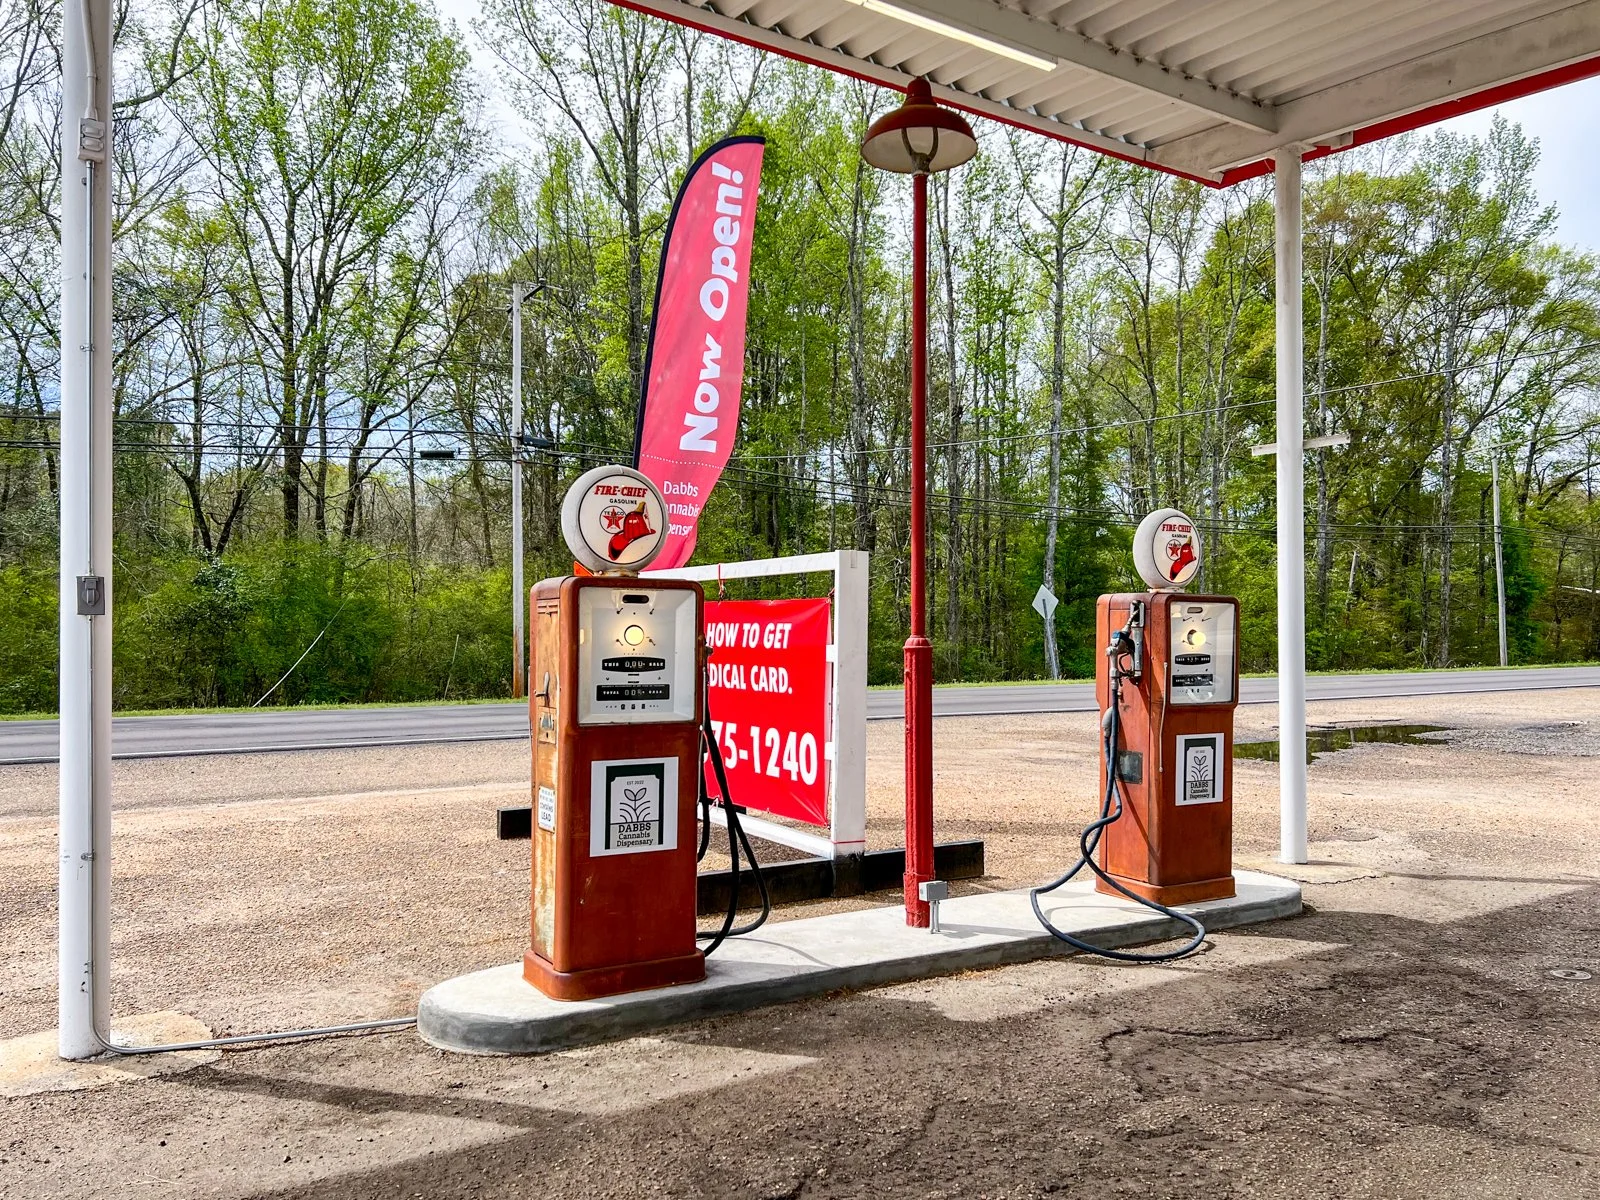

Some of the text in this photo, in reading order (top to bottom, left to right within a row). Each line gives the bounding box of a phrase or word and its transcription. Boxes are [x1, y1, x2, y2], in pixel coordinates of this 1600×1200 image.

[679, 161, 743, 453] Now Open!
[594, 484, 648, 498] FIRE-CHIEF
[663, 480, 699, 497] Dabbs
[1161, 523, 1192, 533] FIRE-CHIEF
[706, 622, 793, 650] HOW TO GET
[708, 662, 793, 695] DICAL CARD.
[703, 719, 818, 786] 75-1240
[1190, 781, 1209, 789] DABBS
[618, 822, 652, 834] DABBS
[616, 838, 654, 848] Dispensary
[618, 831, 651, 841] Cannabis
